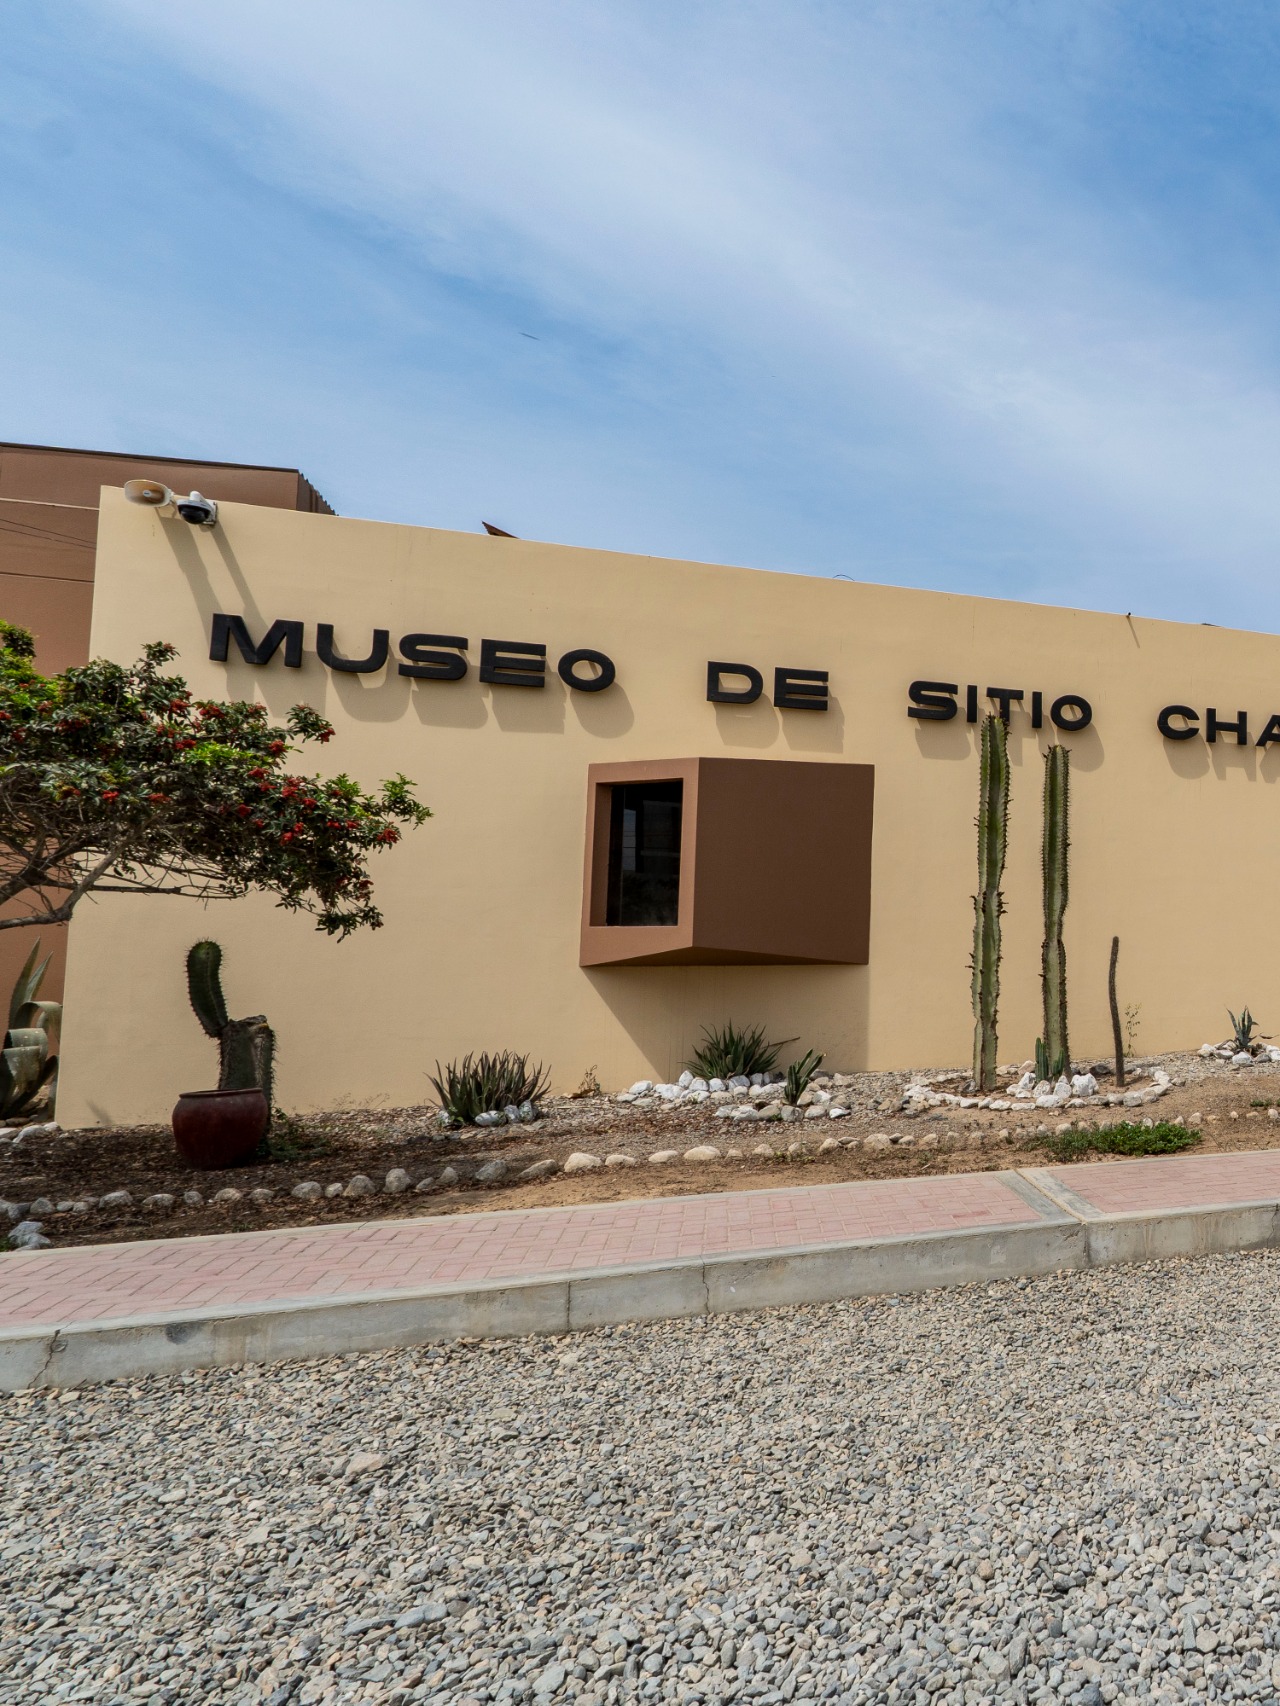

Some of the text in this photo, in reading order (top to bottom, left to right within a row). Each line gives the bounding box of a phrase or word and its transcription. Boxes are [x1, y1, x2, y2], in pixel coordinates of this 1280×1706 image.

[209, 613, 616, 693] MUSEO
[707, 661, 829, 711] DE
[907, 681, 1093, 731] SITIO
